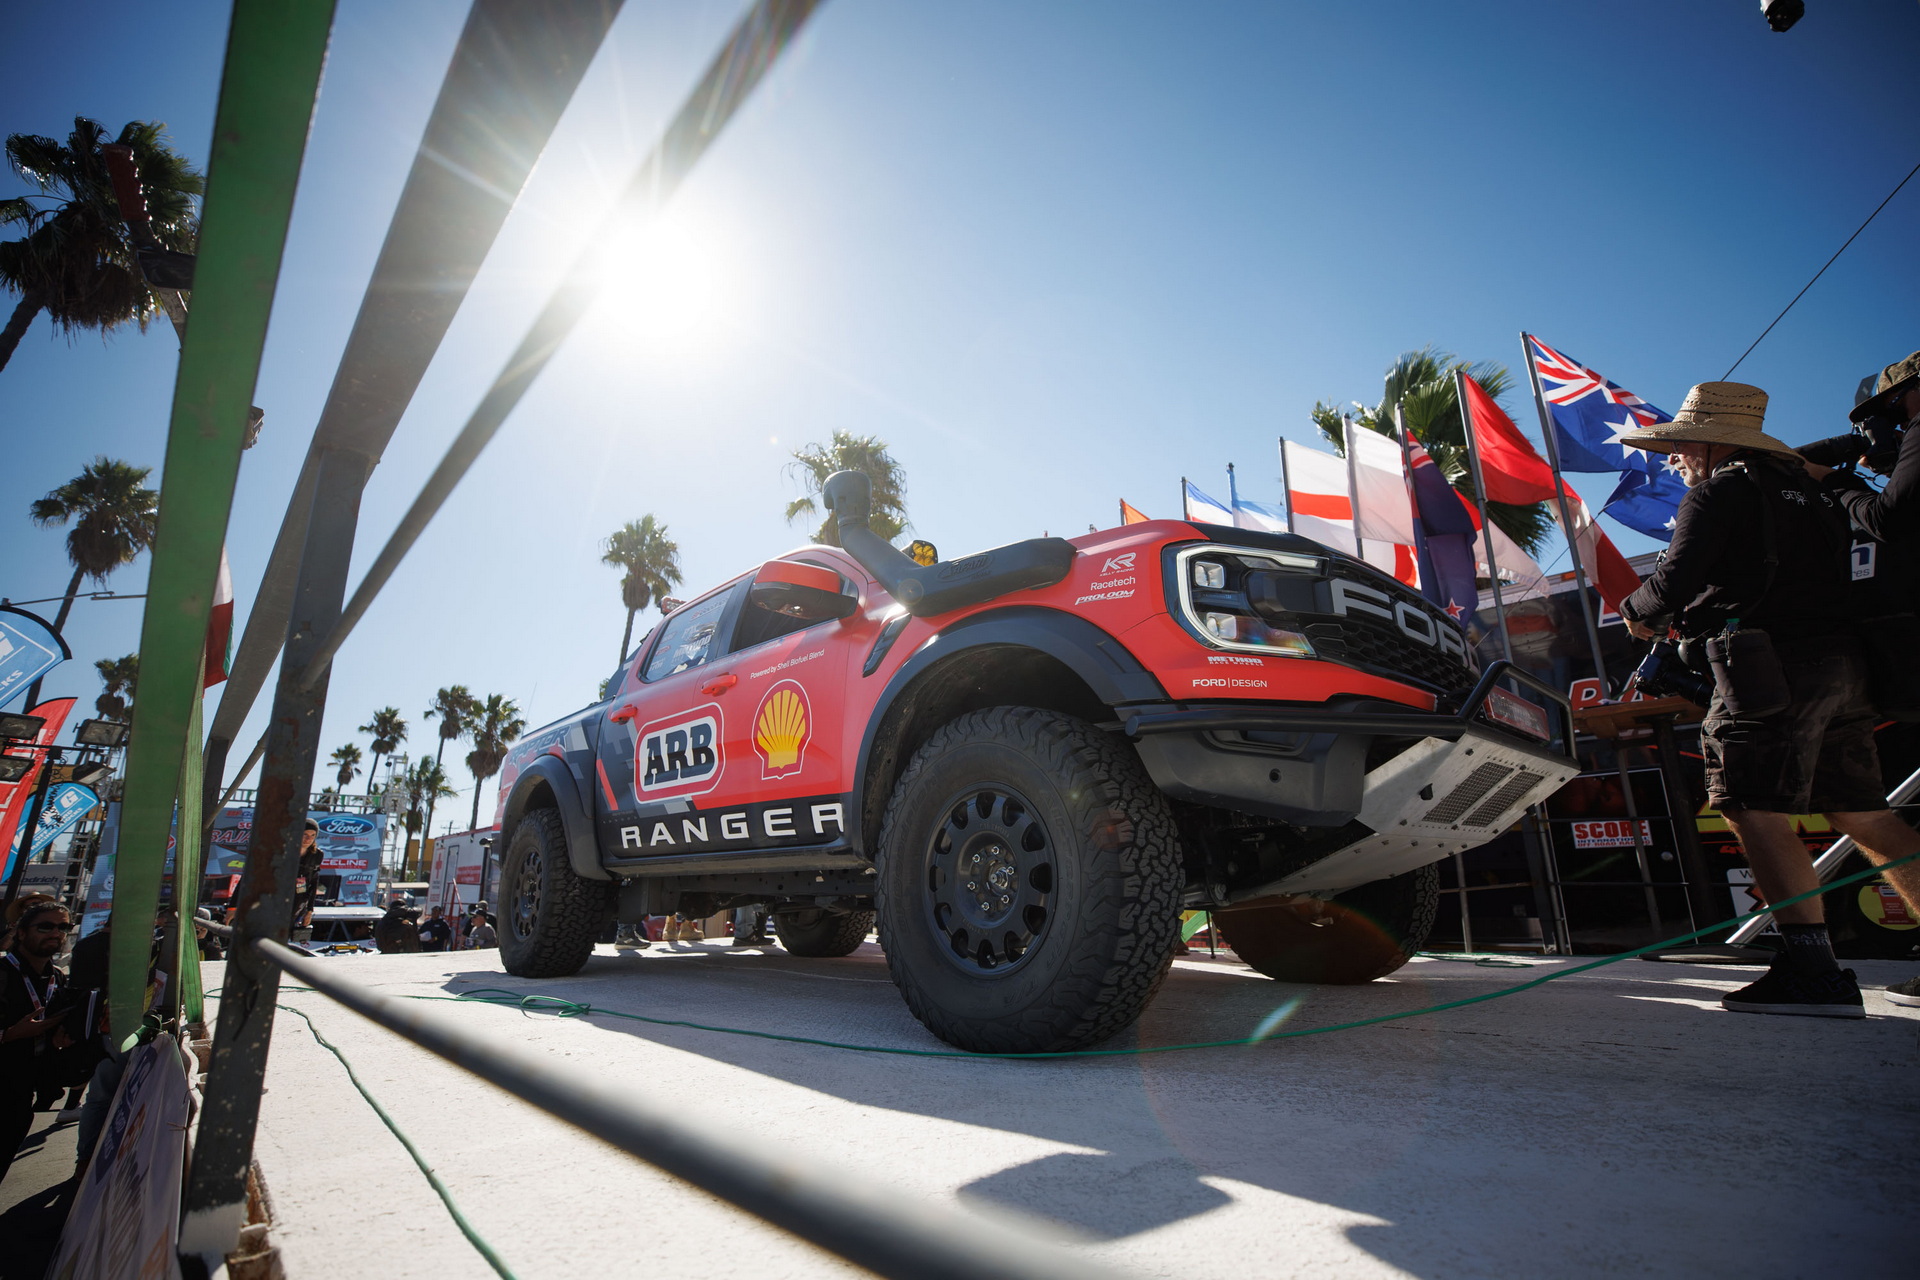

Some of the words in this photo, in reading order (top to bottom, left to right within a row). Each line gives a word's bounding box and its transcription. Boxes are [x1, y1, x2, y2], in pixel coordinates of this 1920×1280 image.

[1090, 576, 1136, 591] Racetech
[1074, 589, 1135, 605] PROLOOM
[750, 667, 771, 679] Powered
[777, 661, 790, 671] Shell
[790, 654, 808, 666] Biofuel
[808, 648, 825, 660] Blend
[1207, 656, 1262, 664] METHOD
[1192, 679, 1227, 688] FORD
[1231, 679, 1268, 688] DESIGN
[644, 723, 718, 786] ARB
[326, 820, 364, 834] Ford
[620, 803, 844, 849] RANGER
[1574, 820, 1648, 840] SCORE
